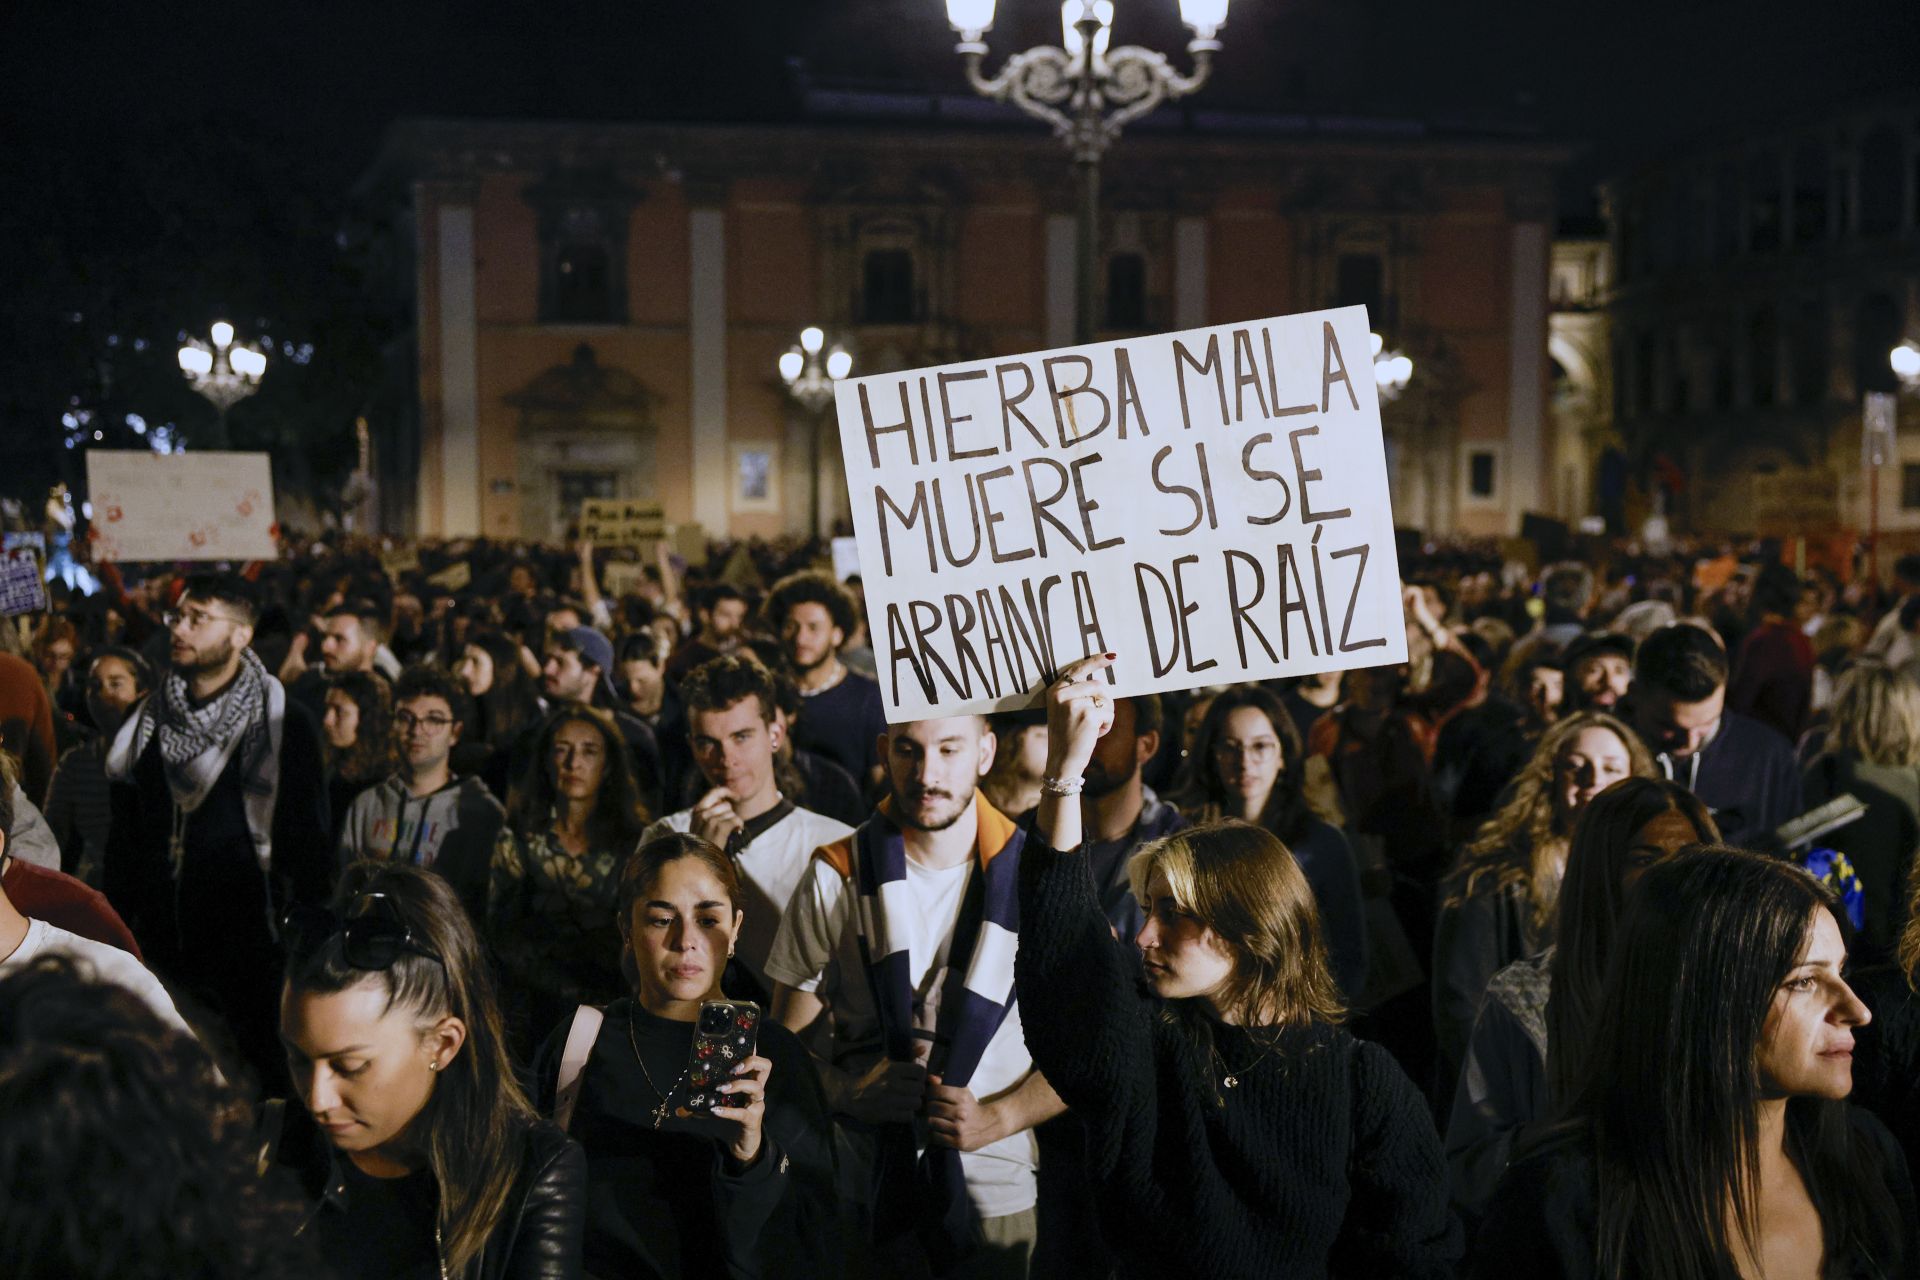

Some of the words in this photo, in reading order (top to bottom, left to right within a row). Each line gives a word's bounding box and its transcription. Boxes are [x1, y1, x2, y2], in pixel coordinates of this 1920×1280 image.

[858, 348, 1150, 468] HIERBA
[1173, 321, 1360, 429] MALA
[875, 452, 1125, 576] MUERE
[1152, 442, 1217, 536] SI
[1242, 425, 1351, 524] SE
[887, 571, 1116, 707] ARRANCA
[1134, 554, 1218, 679] DE
[1223, 524, 1387, 669] RAÍZ
